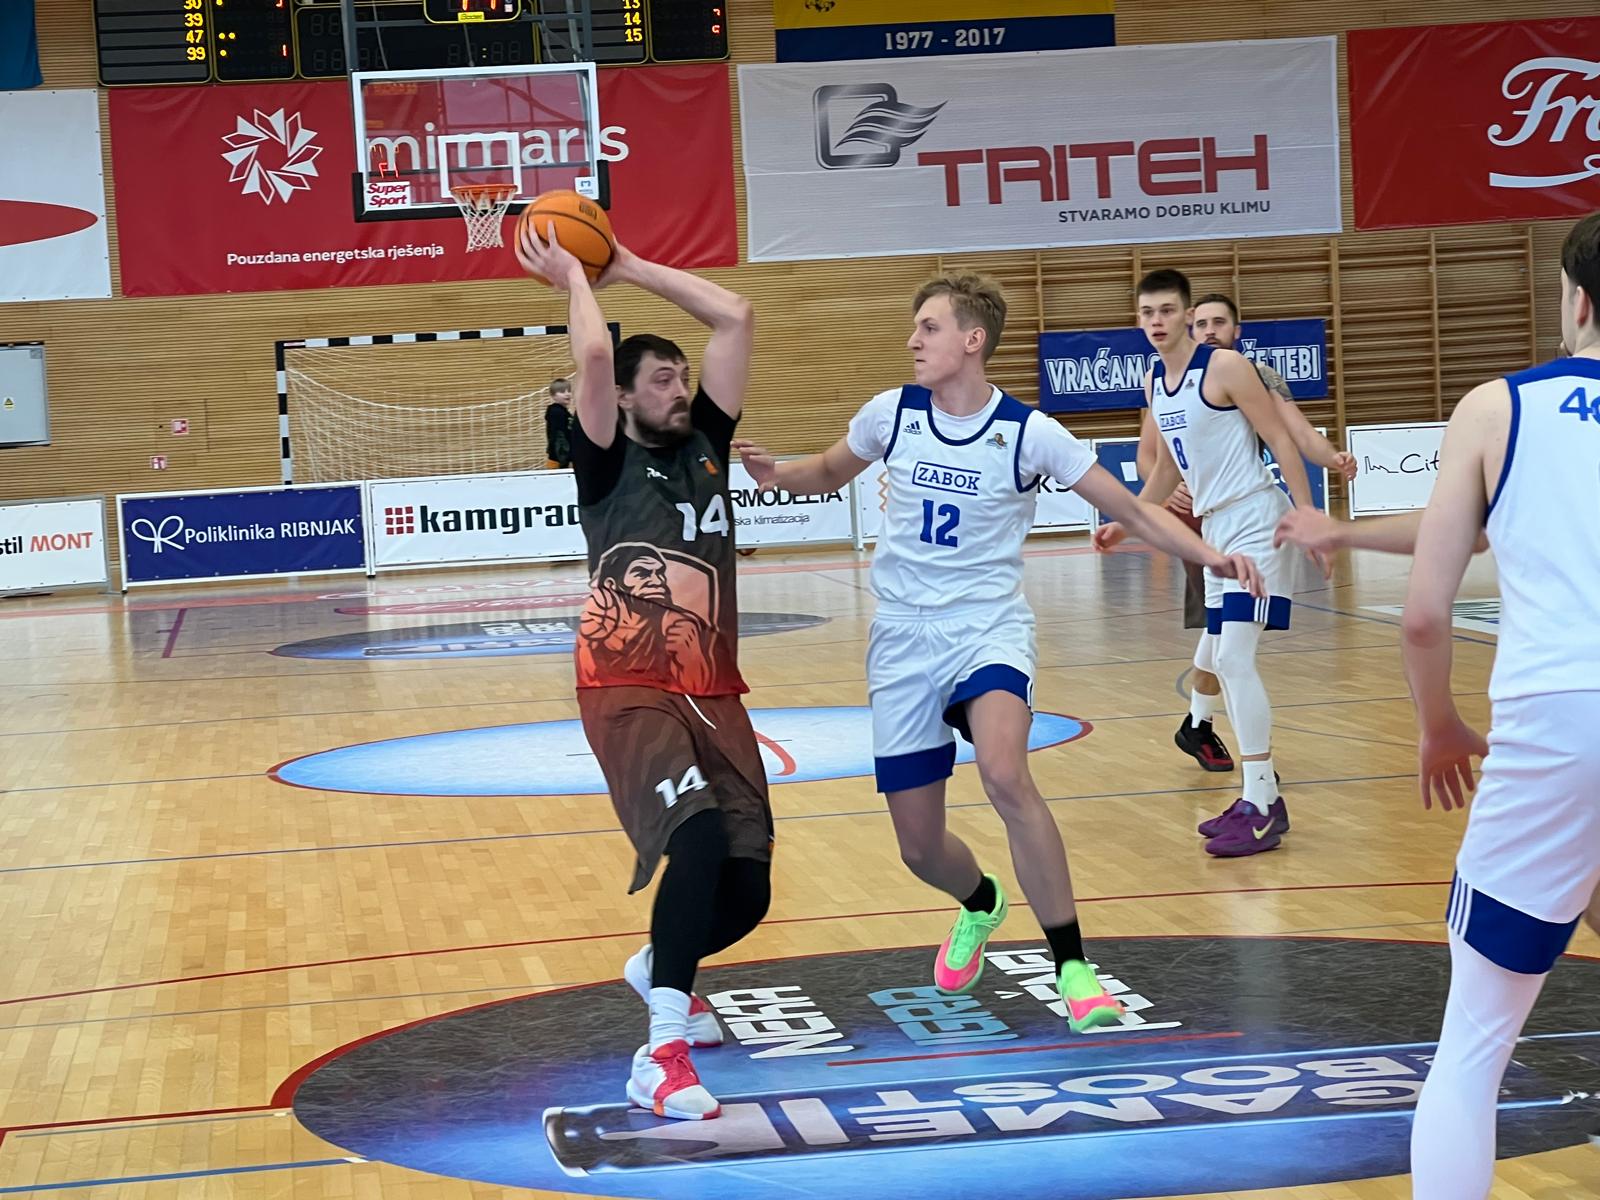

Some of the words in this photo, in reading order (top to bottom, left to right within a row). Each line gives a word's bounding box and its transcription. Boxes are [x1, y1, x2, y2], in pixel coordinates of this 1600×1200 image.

[184, 13, 203, 27] 39
[623, 12, 642, 25] 14
[186, 30, 204, 43] 47
[624, 28, 643, 42] 15
[885, 31, 934, 50] 1977
[955, 28, 1005, 47] 2017
[917, 134, 1269, 207] TRITEH
[367, 183, 408, 195] Super
[369, 194, 407, 207] Sport
[1059, 206, 1150, 223] STVARAMO
[1156, 203, 1215, 218] DOBRU
[1220, 200, 1271, 215] KLIMU
[227, 252, 300, 265] Pouzdana
[303, 247, 385, 264] energetska
[387, 243, 445, 260] rješenja
[1269, 345, 1322, 381] TEBI
[917, 467, 980, 490] ZABOK
[675, 494, 729, 541] 14
[919, 499, 961, 548] 12
[30, 532, 93, 552] MONT
[184, 523, 275, 543] Poliklinika
[281, 518, 356, 538] RIBNJAK
[655, 764, 709, 808] 14
[847, 1056, 1418, 1116] BOOST
[856, 1079, 1425, 1141] GAME
